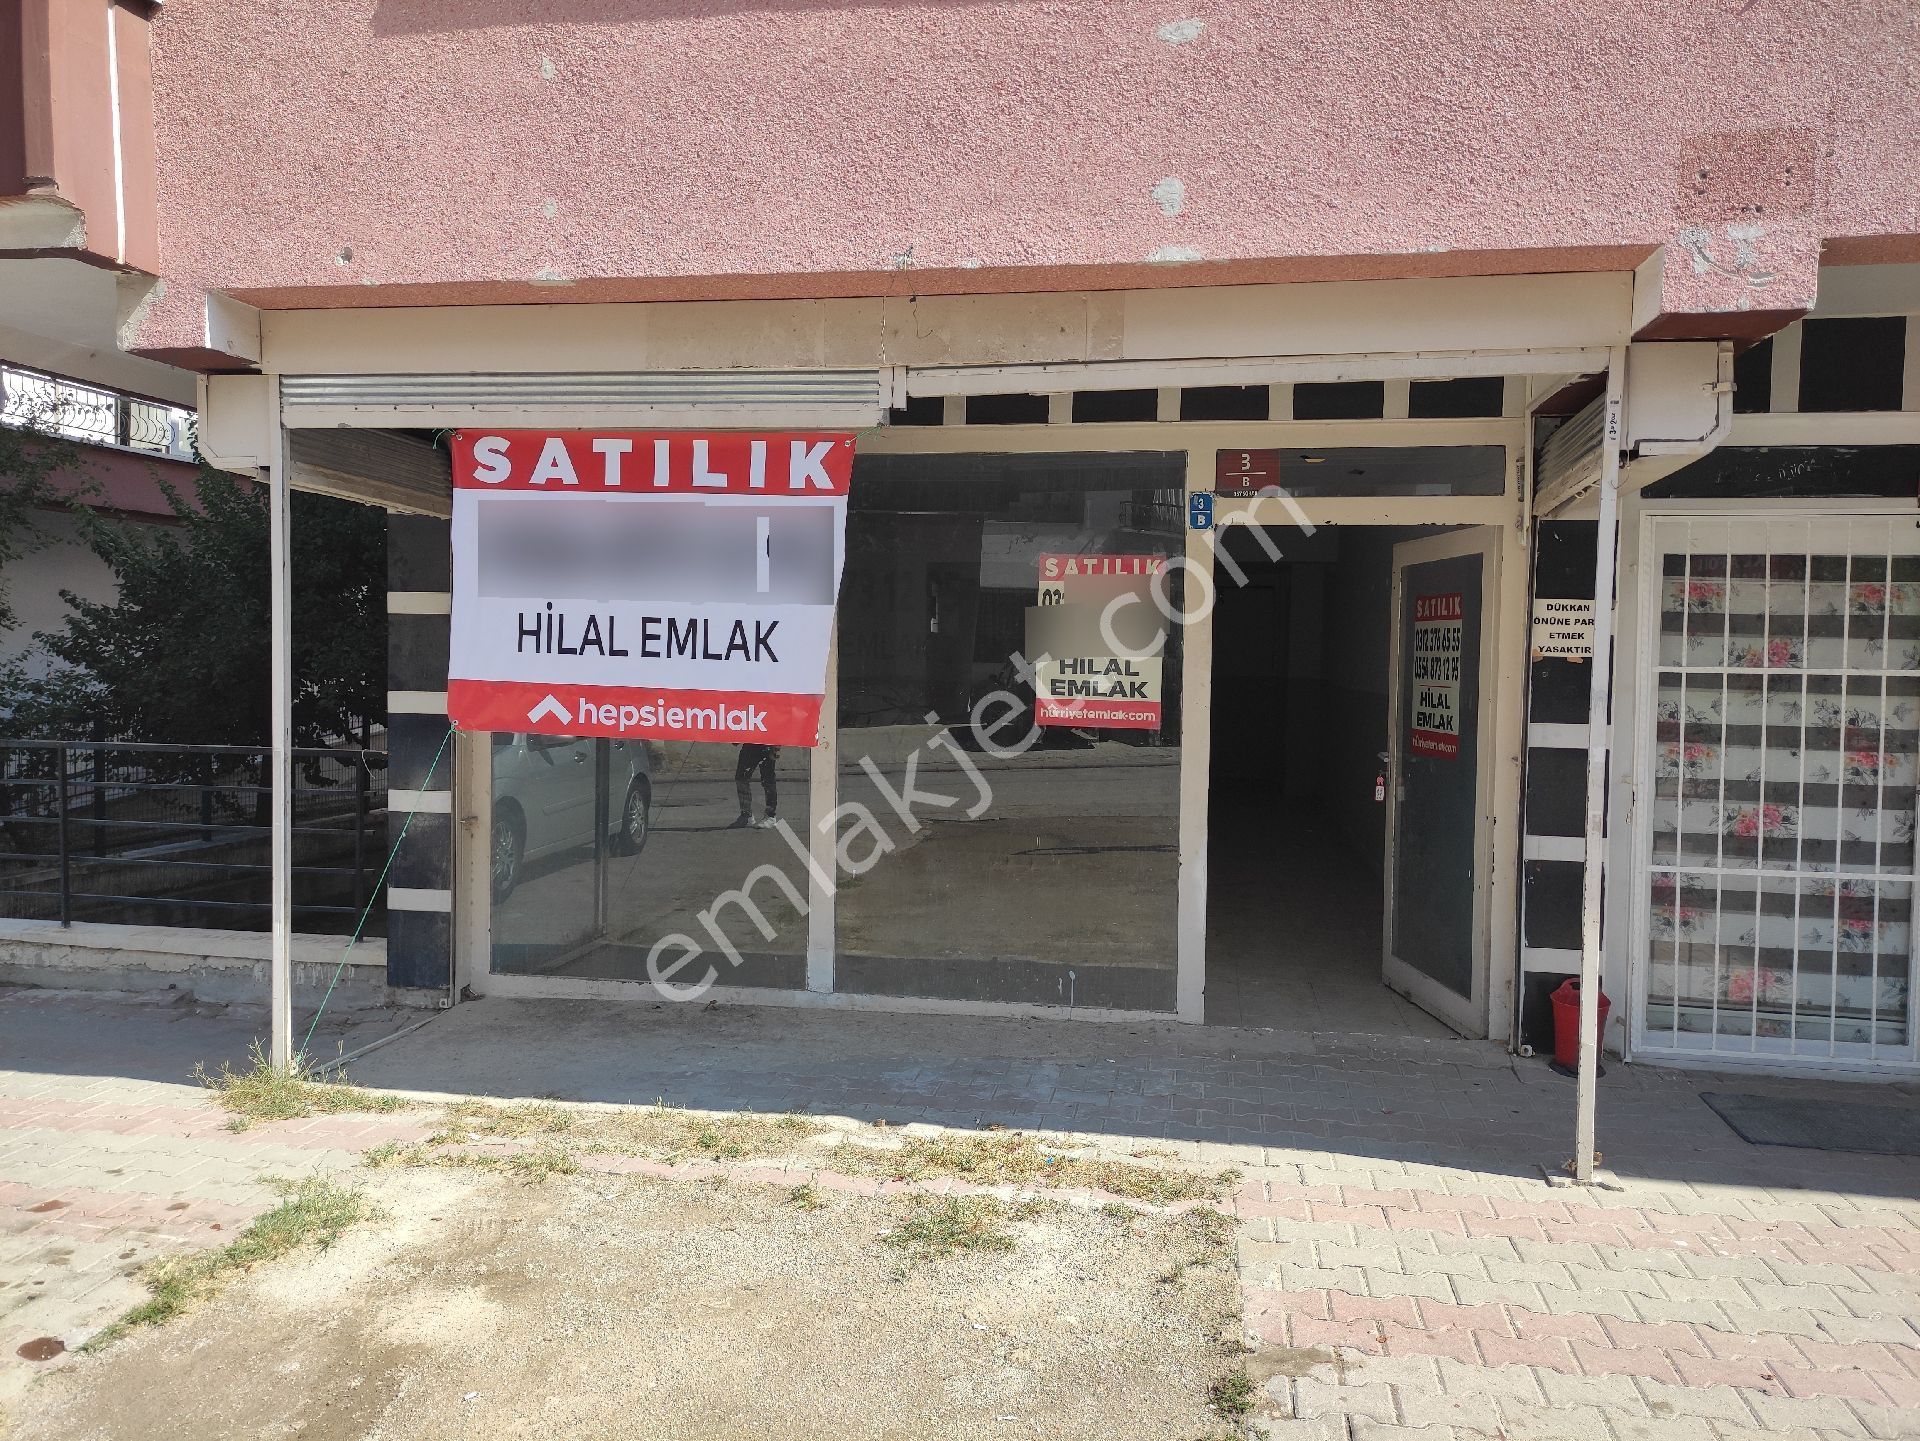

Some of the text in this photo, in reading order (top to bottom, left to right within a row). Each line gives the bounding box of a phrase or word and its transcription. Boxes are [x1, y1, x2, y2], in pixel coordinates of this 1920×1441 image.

[472, 436, 836, 490] SATILIK
[1241, 453, 1251, 470] 3
[1242, 476, 1250, 487] B
[1198, 498, 1204, 509] 3
[1197, 514, 1206, 525] B
[1044, 557, 1162, 577] SATILIK
[1416, 596, 1461, 618] SATILIK
[1546, 602, 1590, 612] DÜKKAN
[1533, 616, 1595, 626] ÖNÜNE PAR
[517, 602, 629, 657] HİLAL
[640, 616, 780, 663] EMLAK
[1549, 632, 1585, 640] ETMEK
[1537, 645, 1592, 654] YASAKTIR
[1050, 678, 1149, 699] EMLAK
[1419, 688, 1451, 709] HİLAL
[578, 698, 768, 733] hepsiemlak
[1416, 711, 1454, 731] EMLAK
